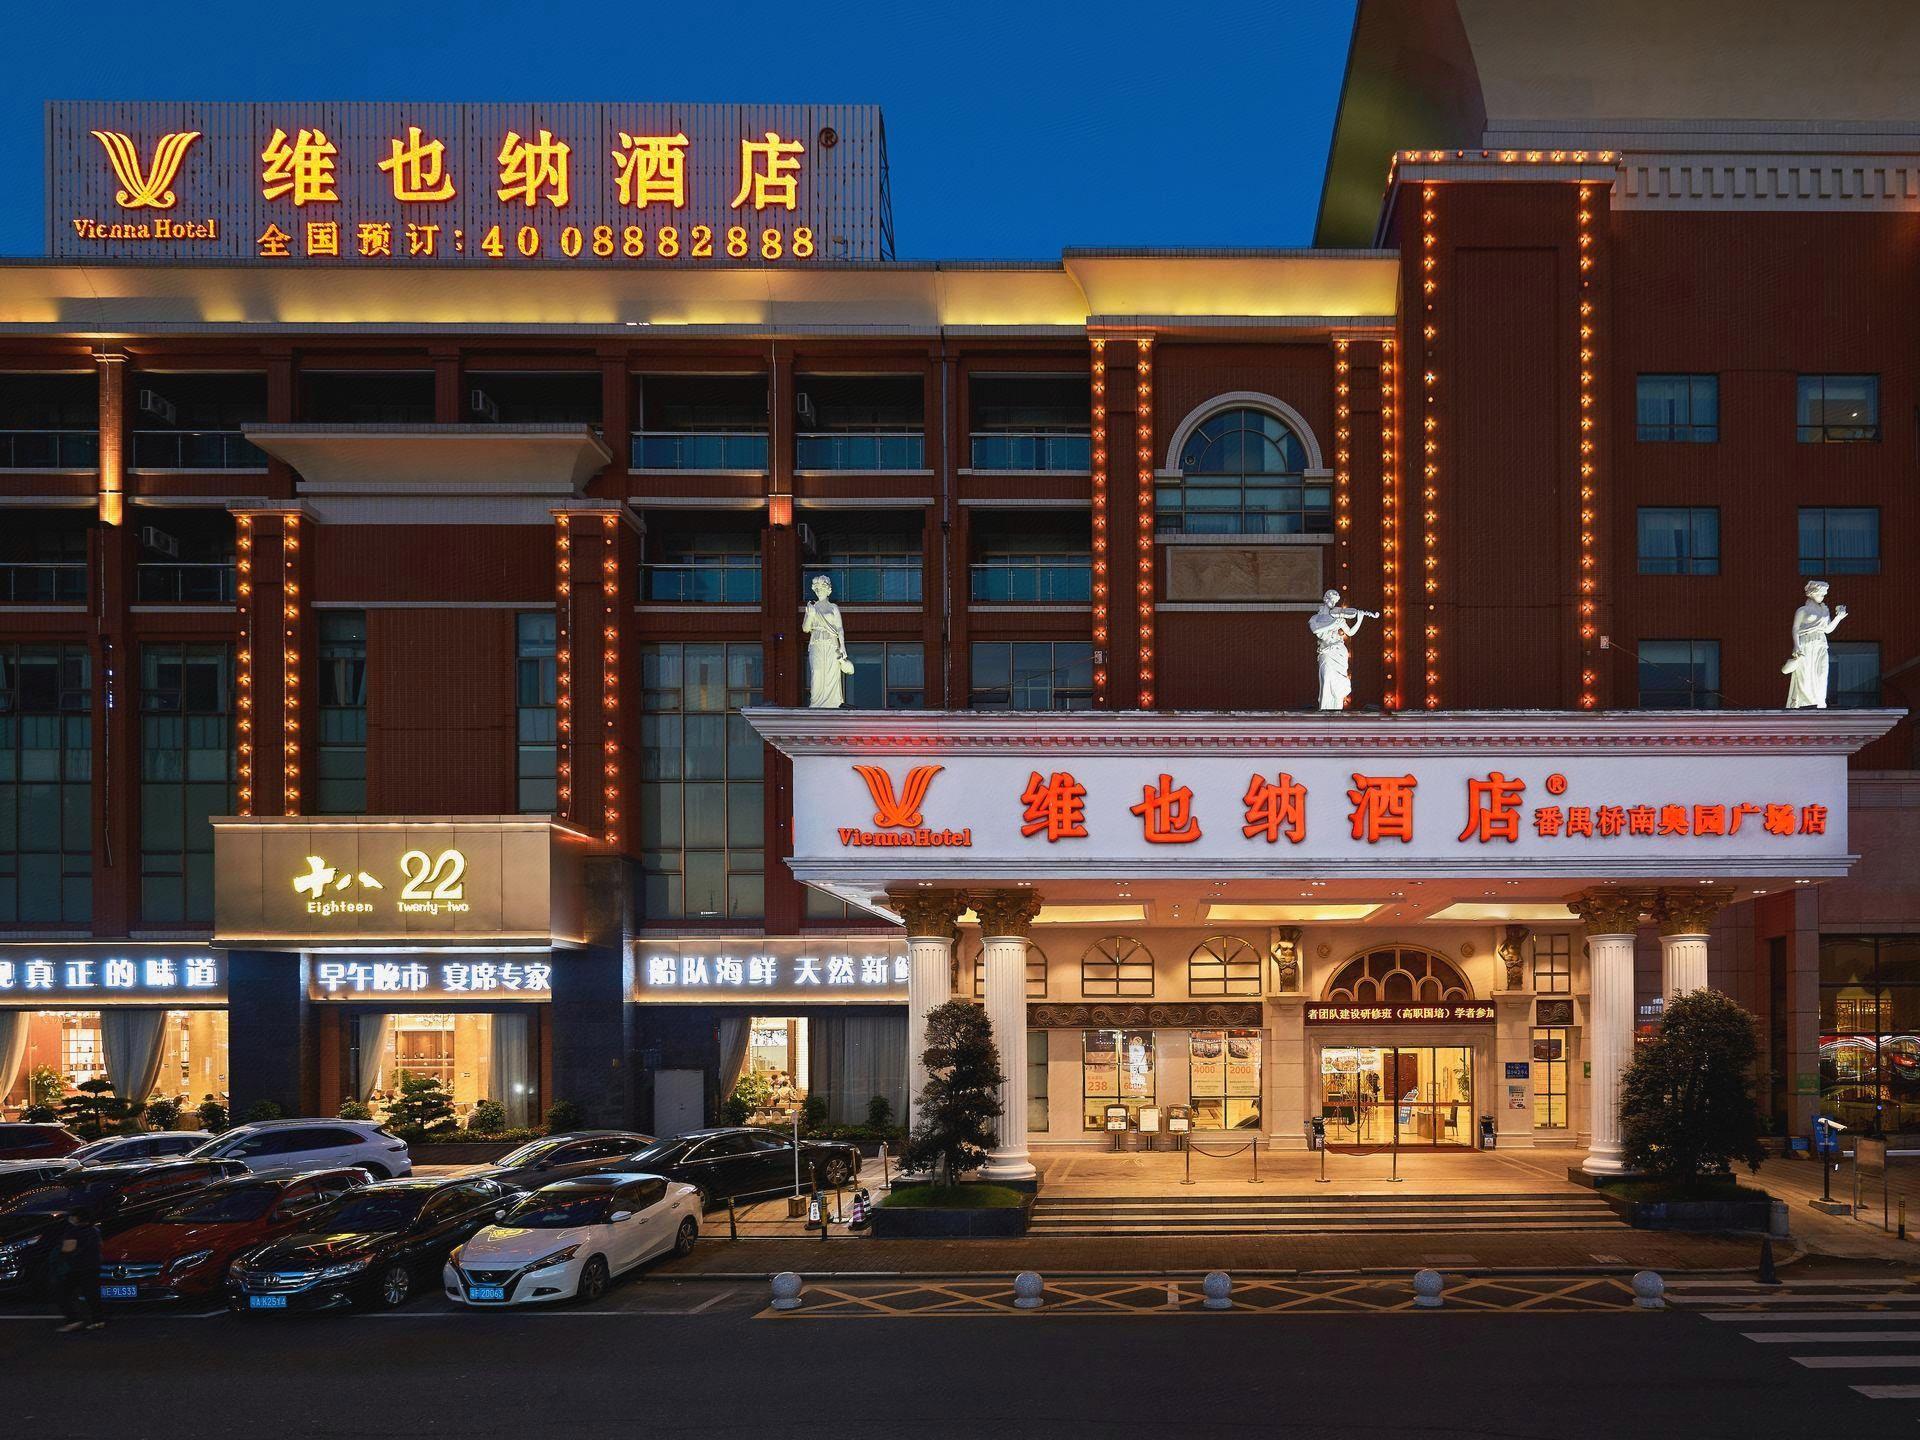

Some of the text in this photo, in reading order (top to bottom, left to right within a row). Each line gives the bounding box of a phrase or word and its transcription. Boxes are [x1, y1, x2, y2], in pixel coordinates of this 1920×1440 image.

[261, 126, 805, 212] 维也纳酒店
[74, 219, 216, 239] Vienna Hotel
[1020, 771, 1527, 844] 维也纳酒店
[1534, 802, 1828, 837] 番禺桥南奥园广场店
[400, 849, 466, 900] 22
[307, 901, 373, 916] Eighteen
[318, 962, 551, 992] 早午晚市 宴席专家
[648, 956, 777, 985] 船队海鲜
[1087, 1081, 1108, 1091] 238
